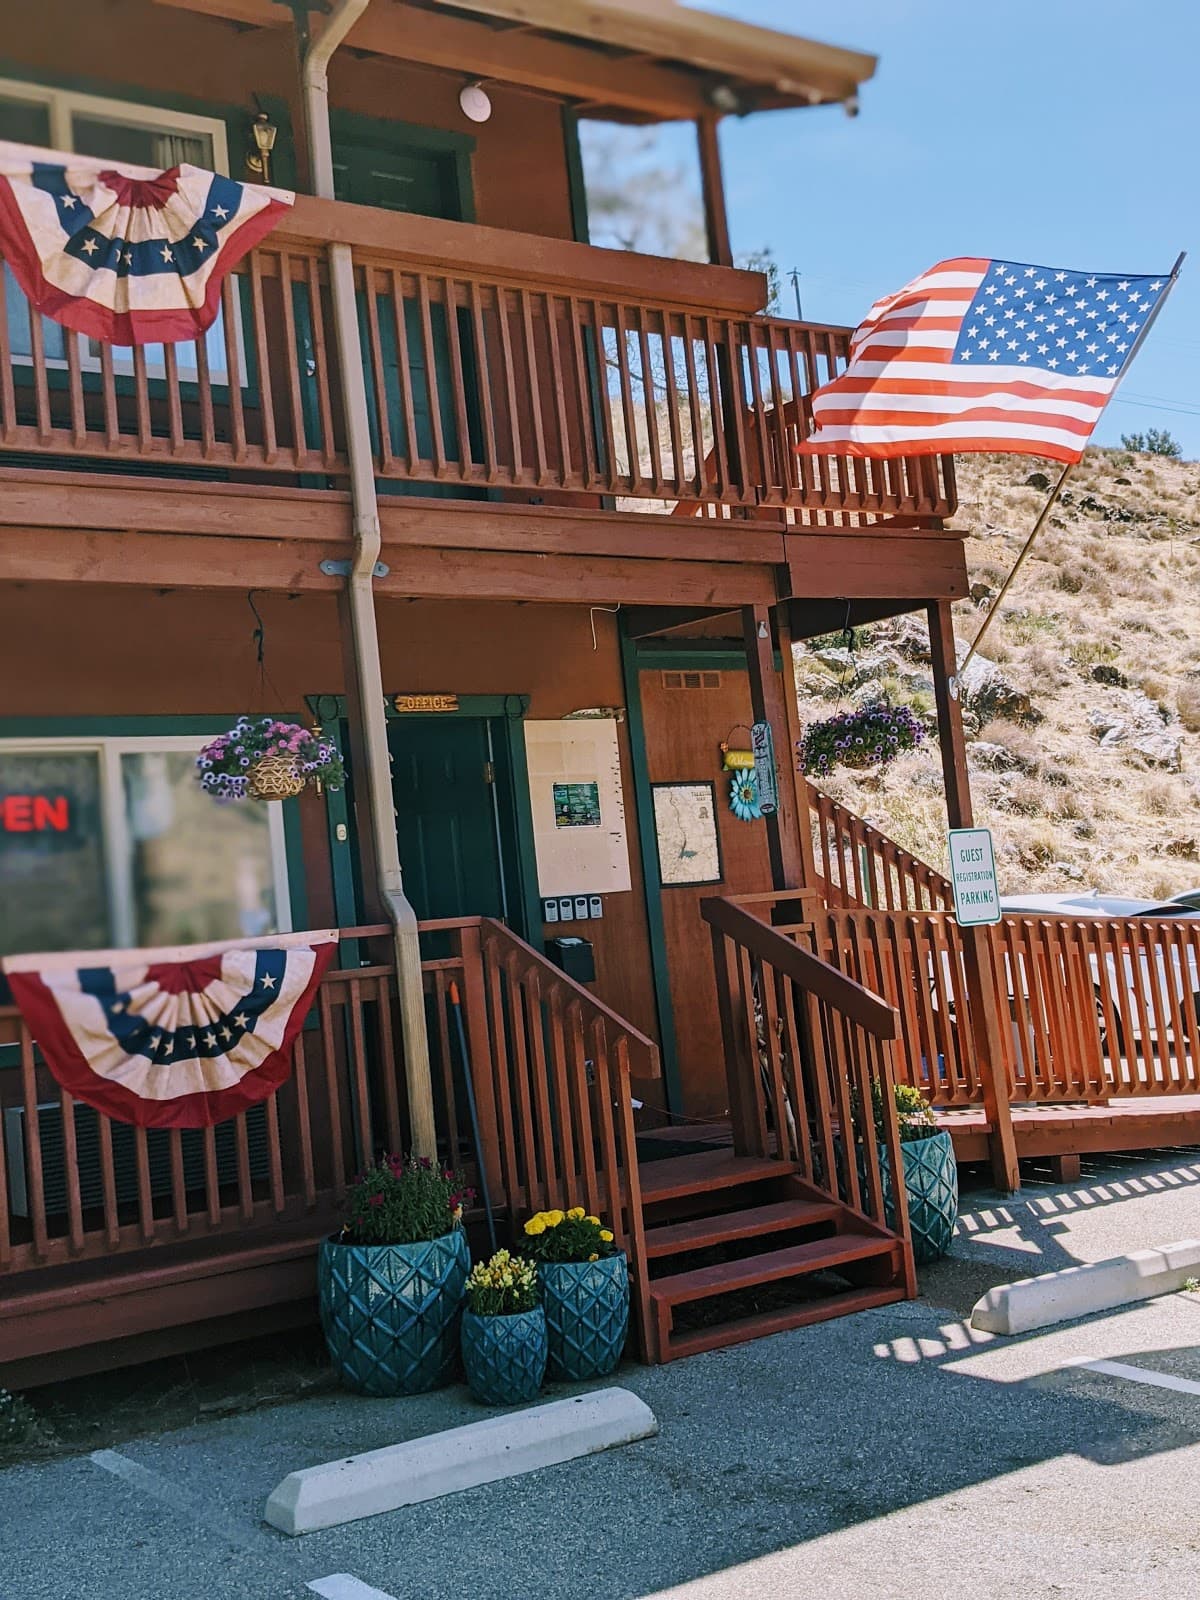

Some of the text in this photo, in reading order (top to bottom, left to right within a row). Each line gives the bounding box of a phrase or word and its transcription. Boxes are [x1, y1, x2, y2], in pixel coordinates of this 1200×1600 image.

[407, 697, 449, 709] OFFICE
[0, 794, 69, 832] EN
[960, 848, 983, 863] GUEST
[956, 870, 993, 882] REGISTRATION
[961, 890, 993, 904] PARKING
